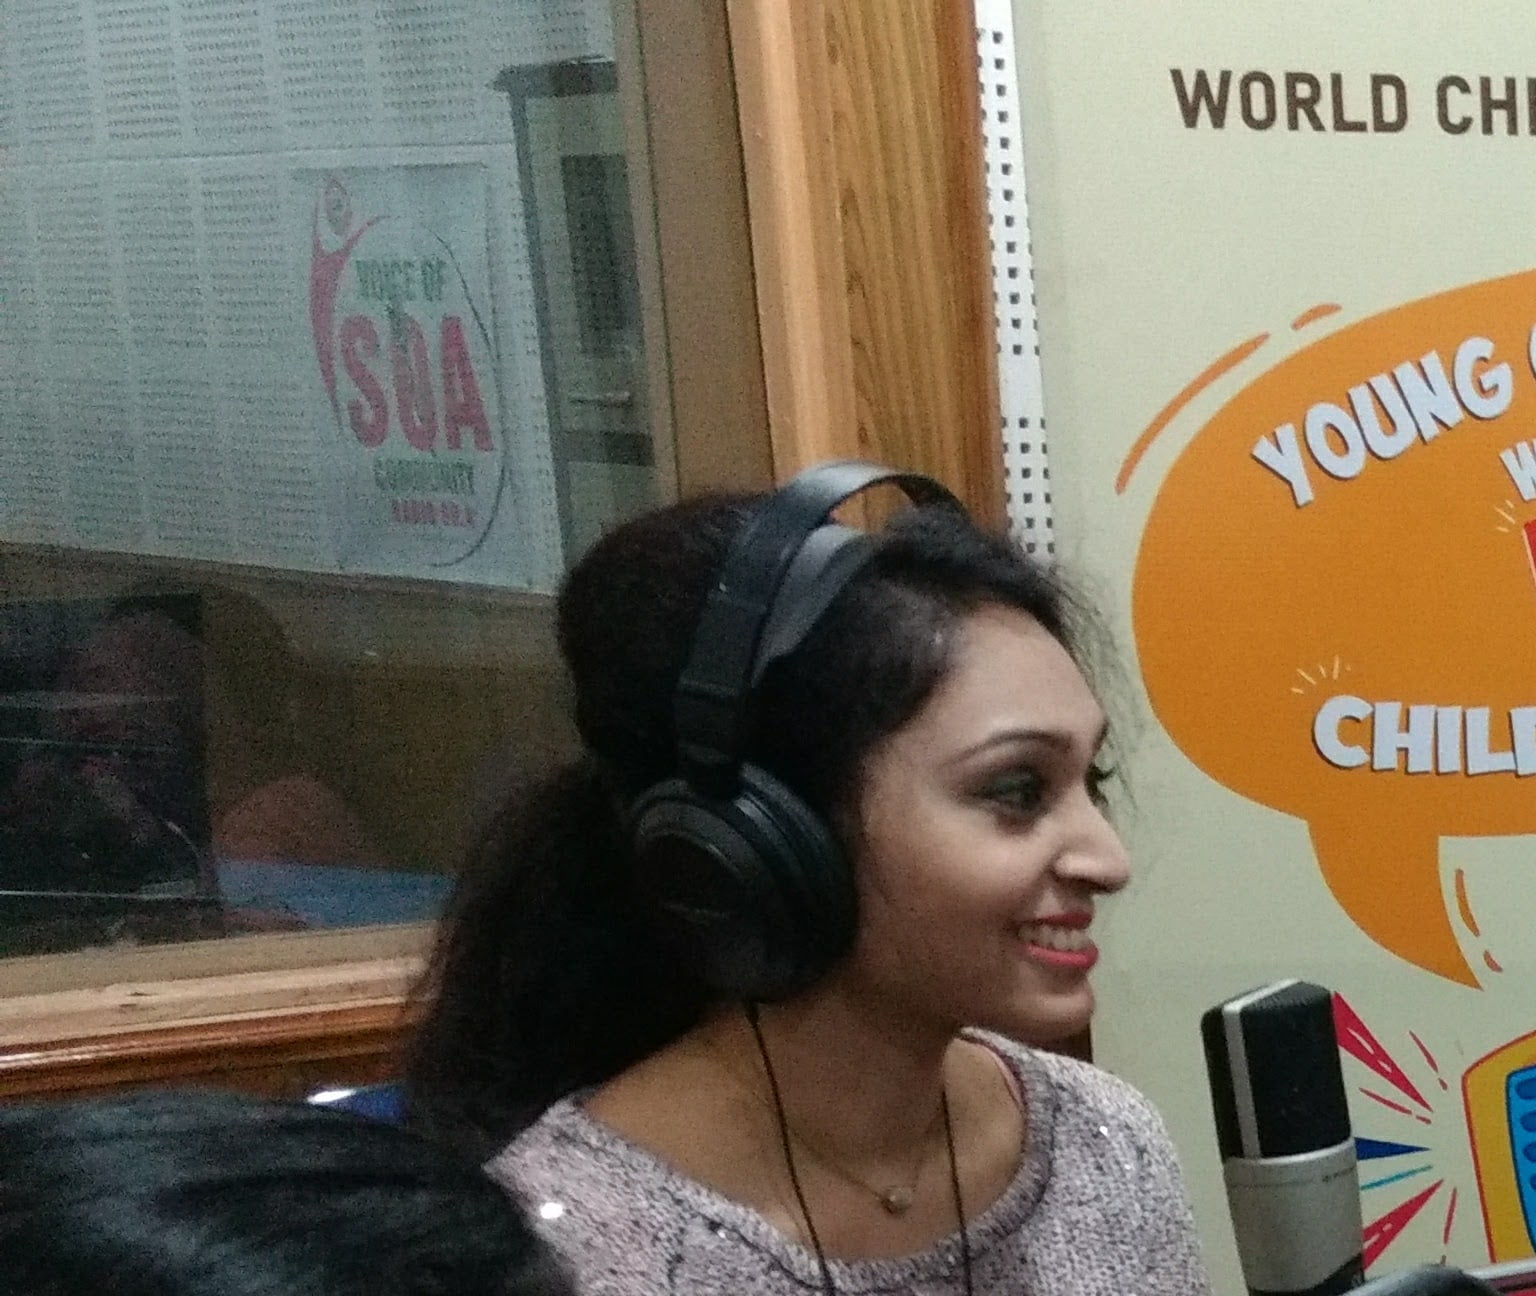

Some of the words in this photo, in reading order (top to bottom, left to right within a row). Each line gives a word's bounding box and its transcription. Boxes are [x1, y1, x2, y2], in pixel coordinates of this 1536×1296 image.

[1171, 70, 1408, 132] WORLD
[341, 315, 494, 452] SOA
[1252, 336, 1515, 506] YOUNG
